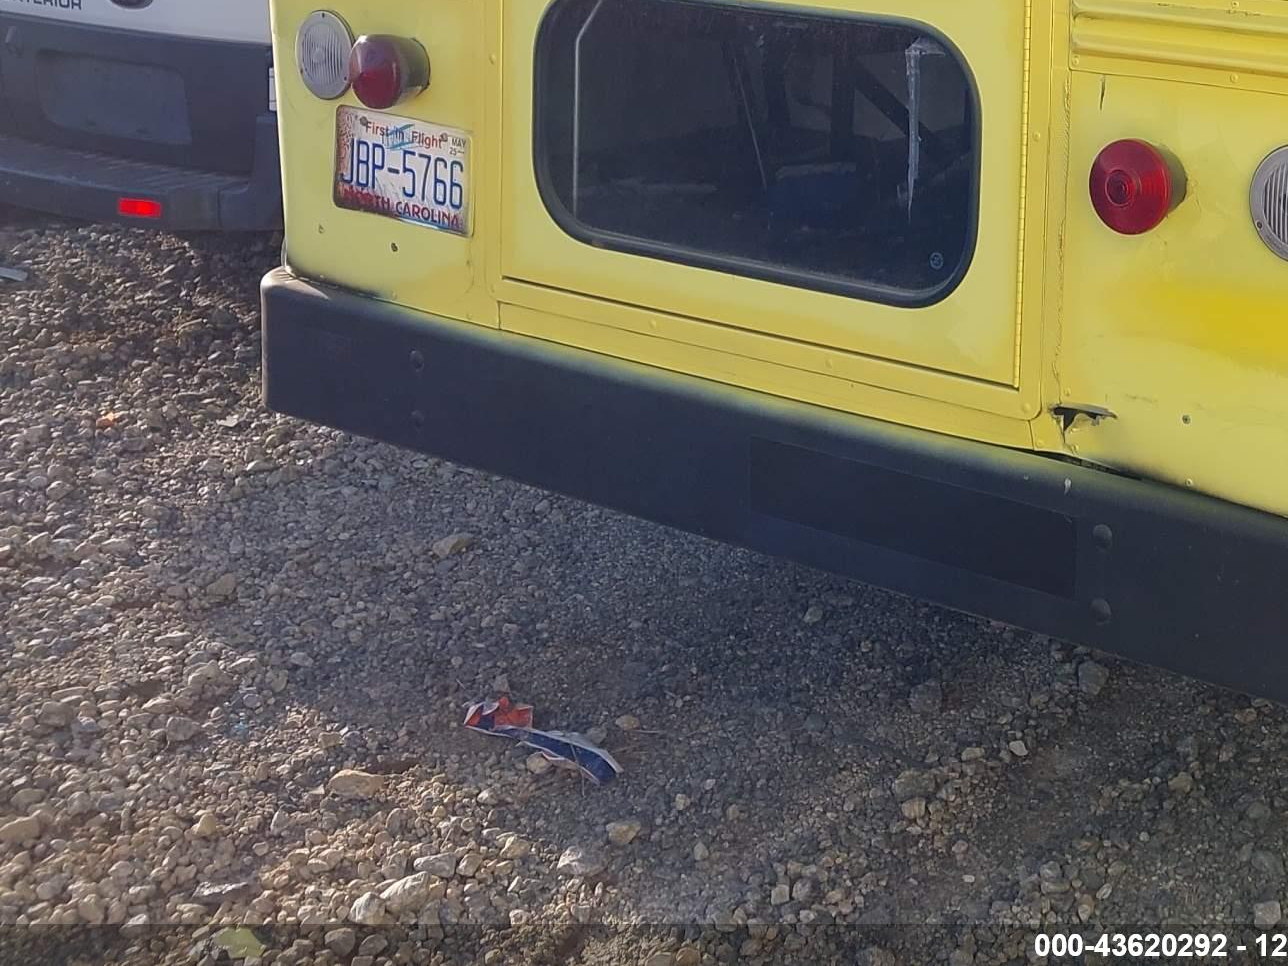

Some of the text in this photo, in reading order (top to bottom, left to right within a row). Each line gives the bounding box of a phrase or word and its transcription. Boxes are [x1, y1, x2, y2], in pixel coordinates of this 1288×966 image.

[365, 120, 390, 138] First
[411, 130, 443, 149] Flight
[339, 137, 464, 210] JBP-5766
[395, 200, 460, 228] CAROLINA
